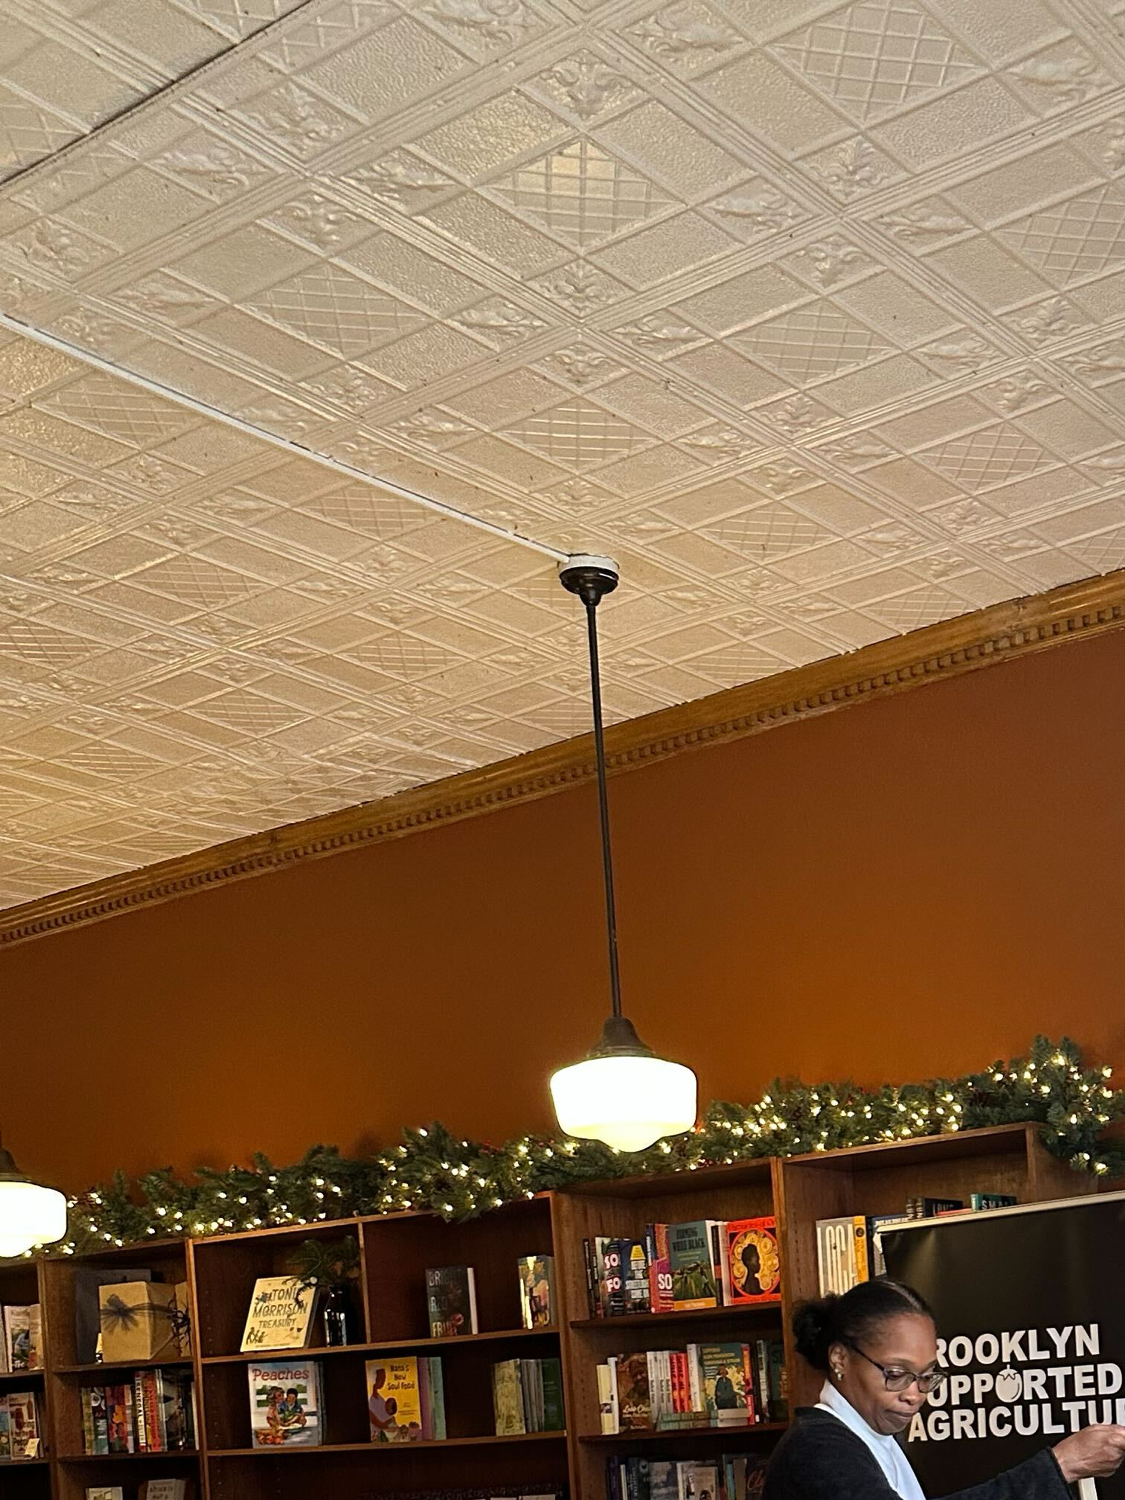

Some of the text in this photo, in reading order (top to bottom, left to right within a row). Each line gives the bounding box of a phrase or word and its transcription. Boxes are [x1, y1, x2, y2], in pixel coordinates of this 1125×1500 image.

[252, 1302, 309, 1318] MORRISON
[936, 1323, 1100, 1367] ROOKLYN
[252, 1367, 310, 1382] Peaches
[928, 1363, 1123, 1408] UPPORTED
